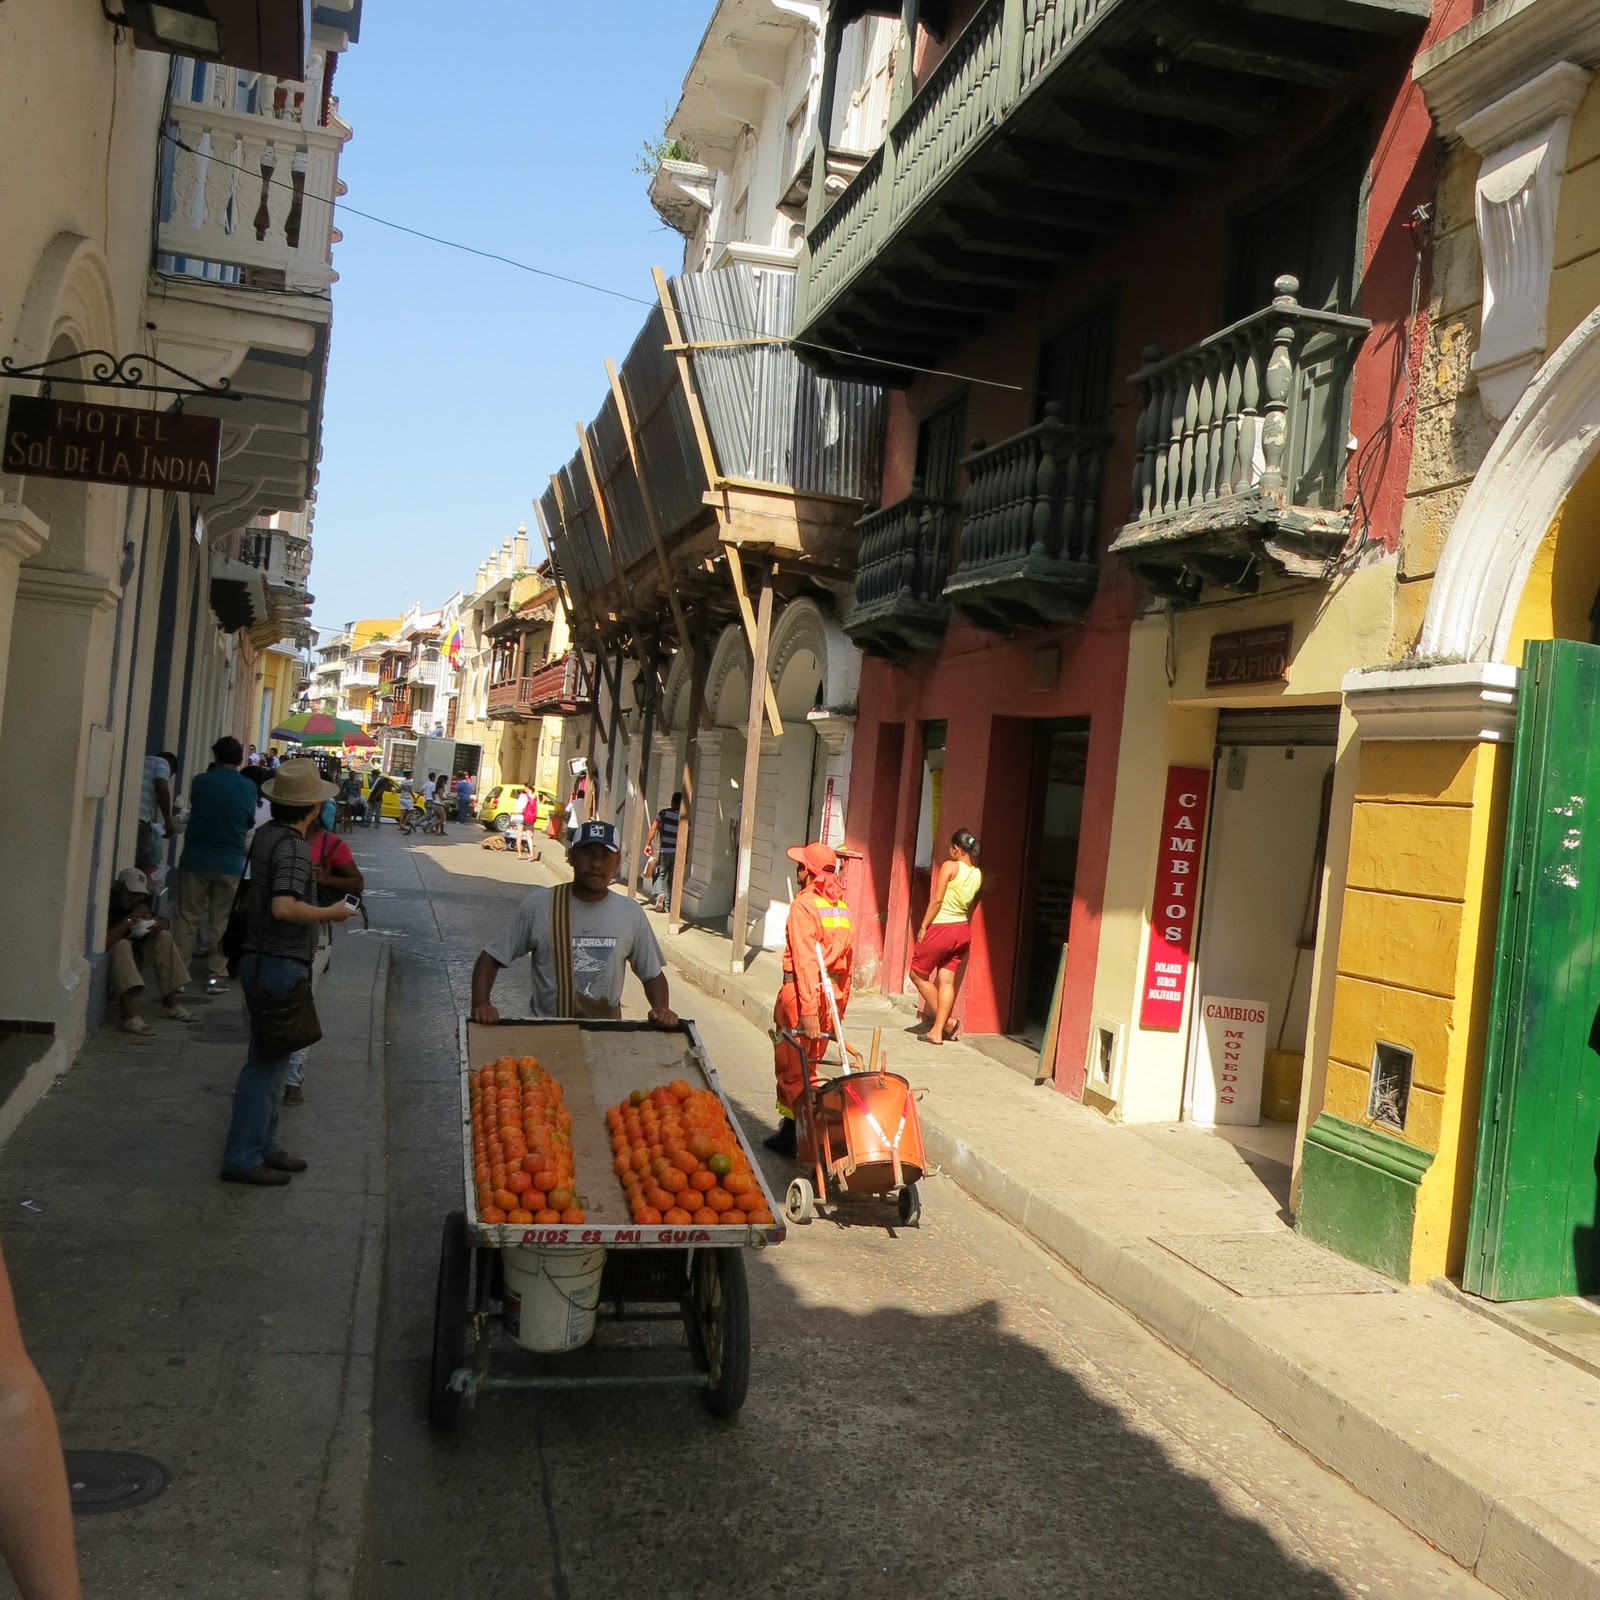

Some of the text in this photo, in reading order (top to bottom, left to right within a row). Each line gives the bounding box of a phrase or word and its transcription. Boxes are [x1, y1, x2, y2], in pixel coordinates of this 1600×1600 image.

[57, 407, 168, 442] HOTEL
[64, 445, 93, 473] DE
[97, 440, 130, 478] LA
[140, 446, 212, 487] INDIA
[1165, 793, 1197, 941] CAMBIOS
[577, 938, 616, 947] JORDAN
[1154, 961, 1182, 974] DOLARES
[1156, 976, 1177, 988] EUROS
[1147, 988, 1181, 1002] BOLIVARES
[1206, 1004, 1265, 1023] CAMBIOS
[1220, 1029, 1245, 1104] MONEDAS
[522, 1230, 569, 1244] DIOS
[615, 1230, 642, 1242] MI
